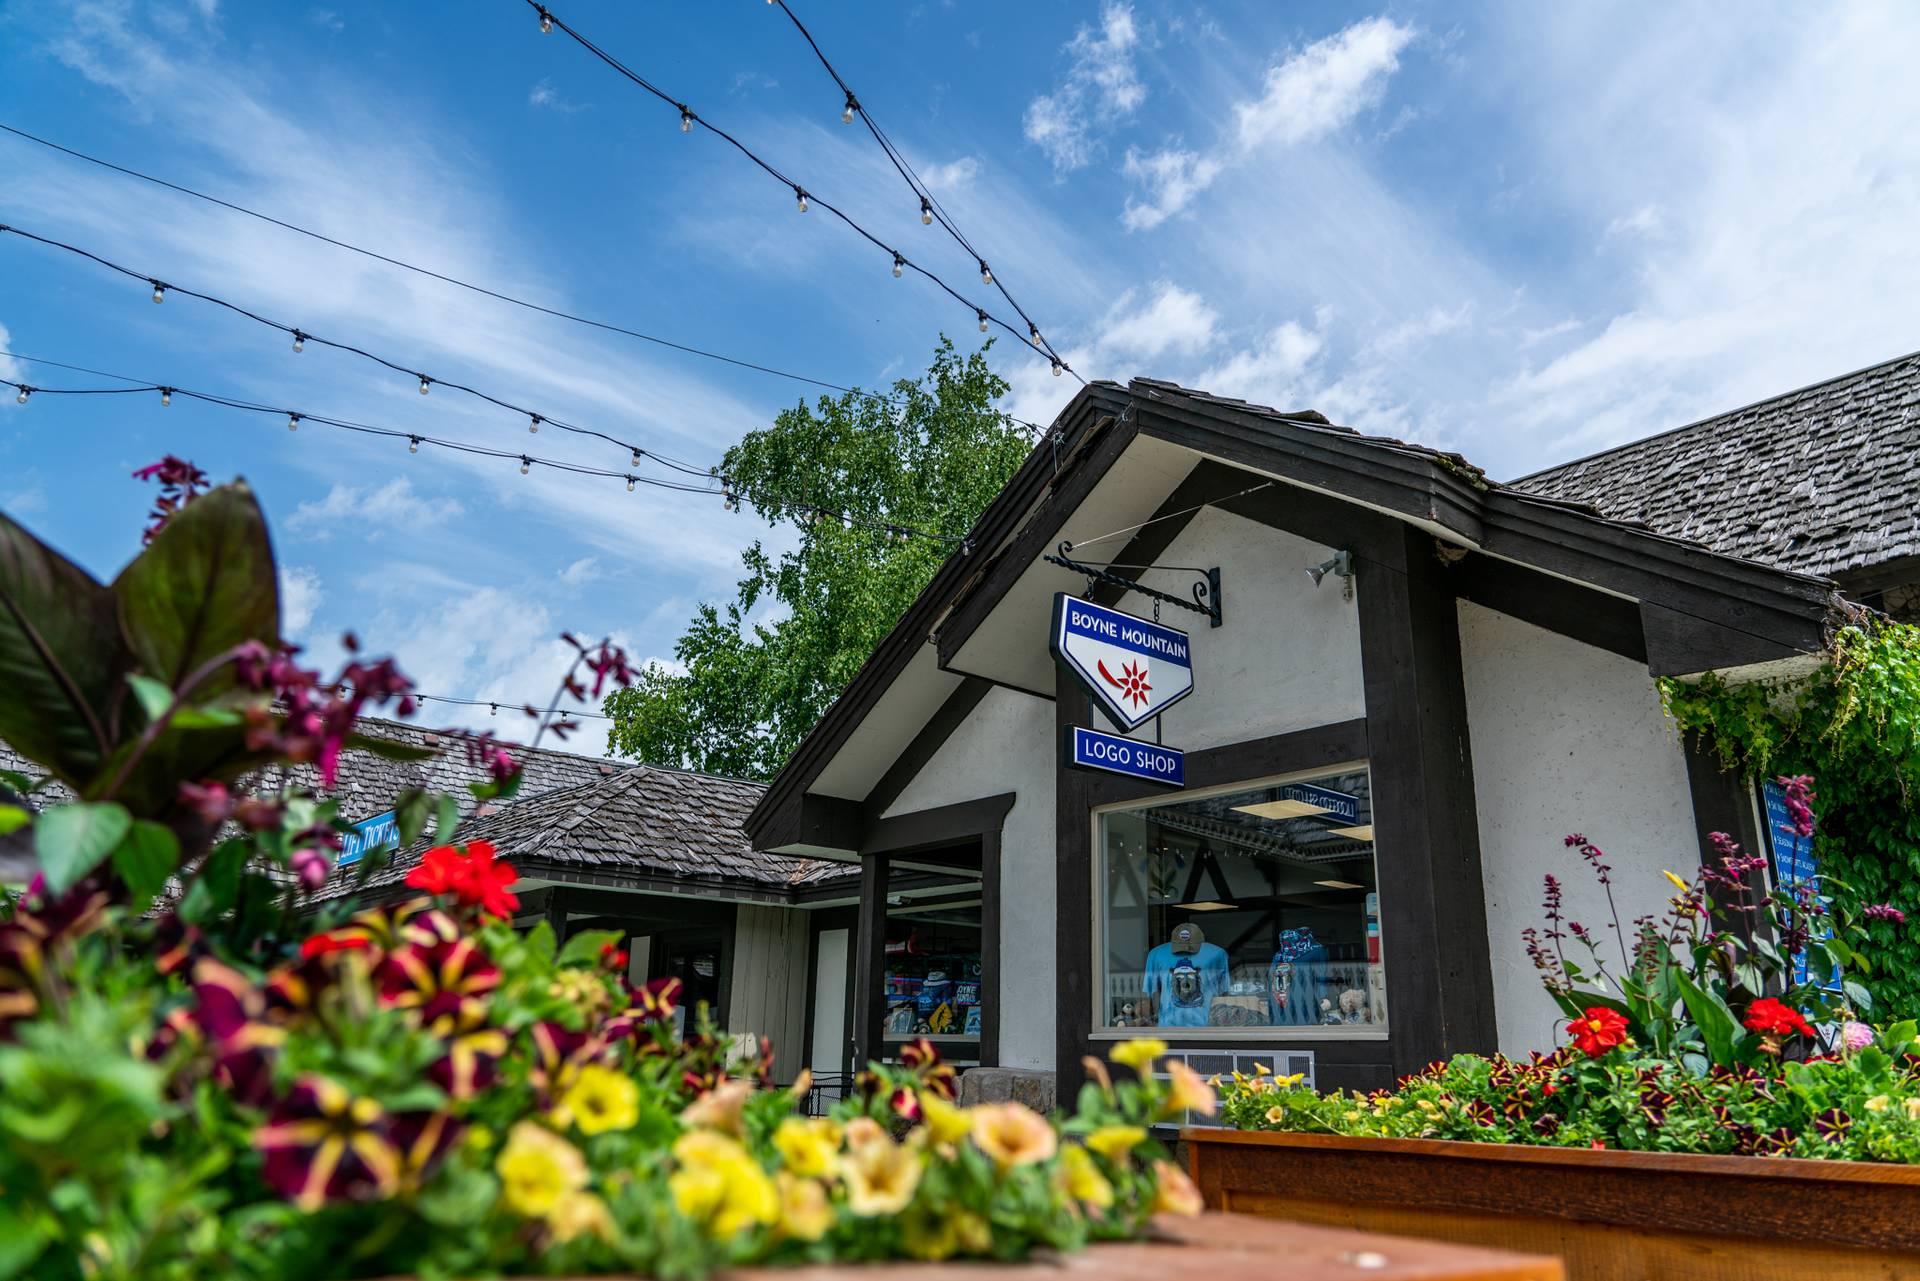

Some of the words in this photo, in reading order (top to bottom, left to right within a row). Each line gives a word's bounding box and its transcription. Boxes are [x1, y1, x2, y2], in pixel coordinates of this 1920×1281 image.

[1071, 610, 1117, 638] BOYNE
[1121, 628, 1186, 659] MOUNTAIN
[1085, 738, 1130, 764] LOGO
[1136, 750, 1175, 774] SHOP
